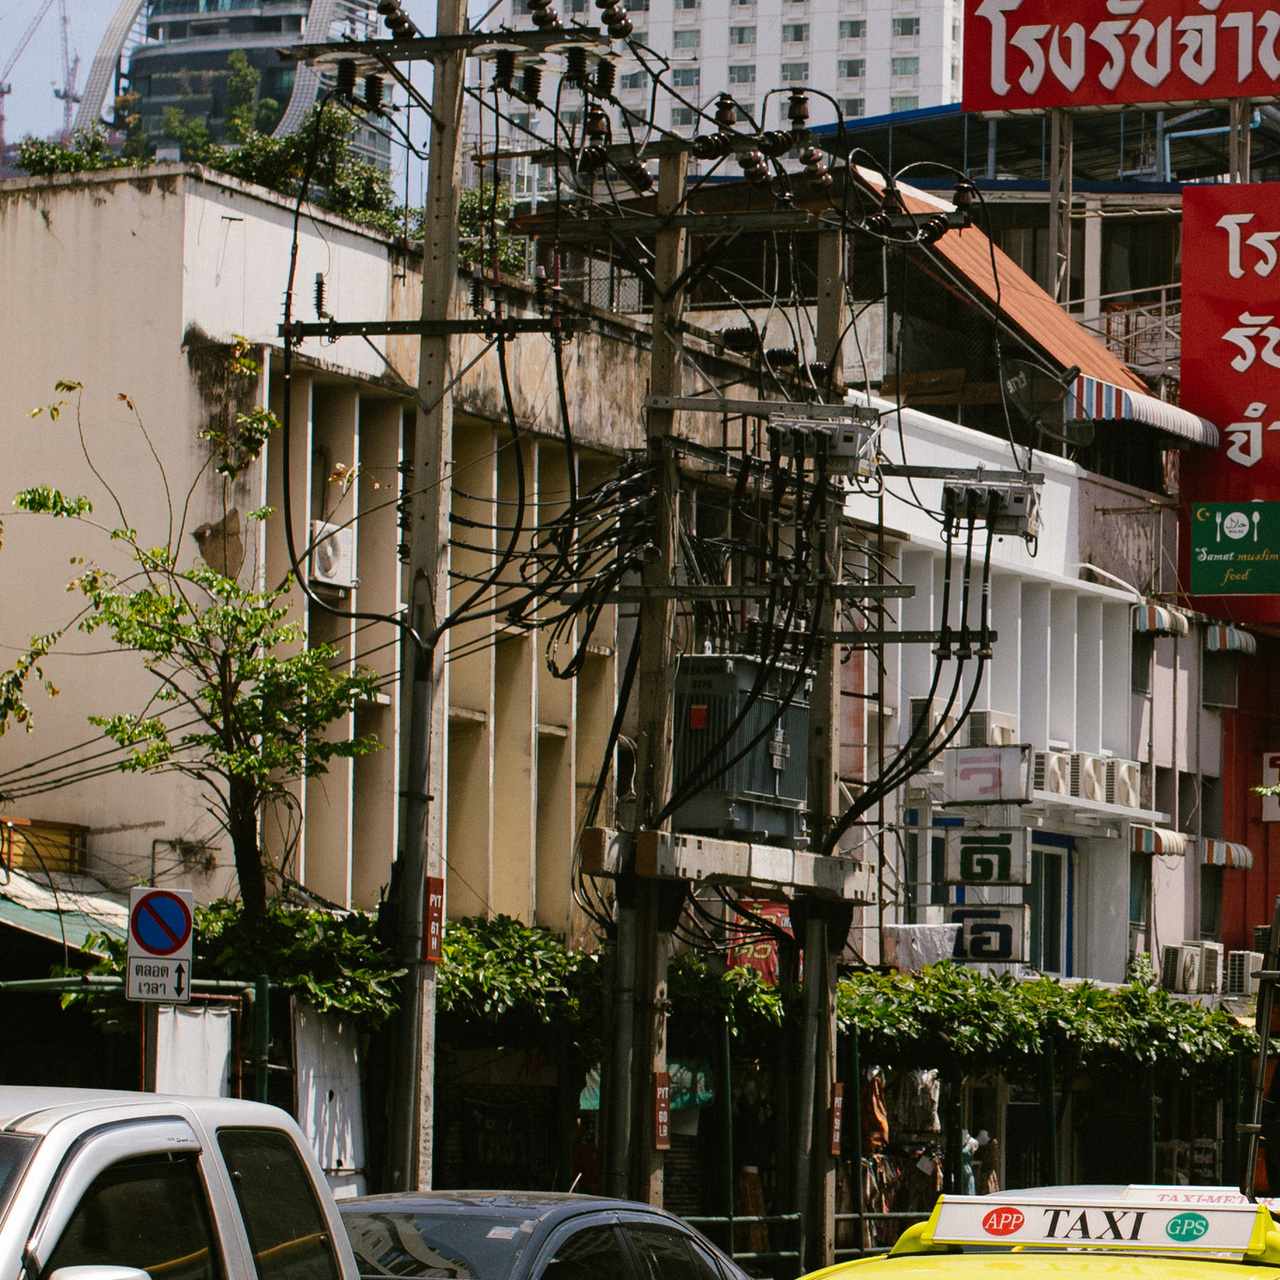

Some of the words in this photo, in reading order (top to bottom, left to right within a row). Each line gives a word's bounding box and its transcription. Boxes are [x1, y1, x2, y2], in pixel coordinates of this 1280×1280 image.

[1195, 547, 1235, 561] Samat
[1237, 549, 1279, 561] muslim
[1221, 569, 1252, 586] food
[135, 965, 169, 978] ตลอด
[138, 982, 166, 995] เวลา
[1157, 1194, 1275, 1206] TAXI-METR
[984, 1213, 1023, 1231] APP
[1043, 1209, 1147, 1239] TAXI
[1167, 1220, 1206, 1236] GPS
